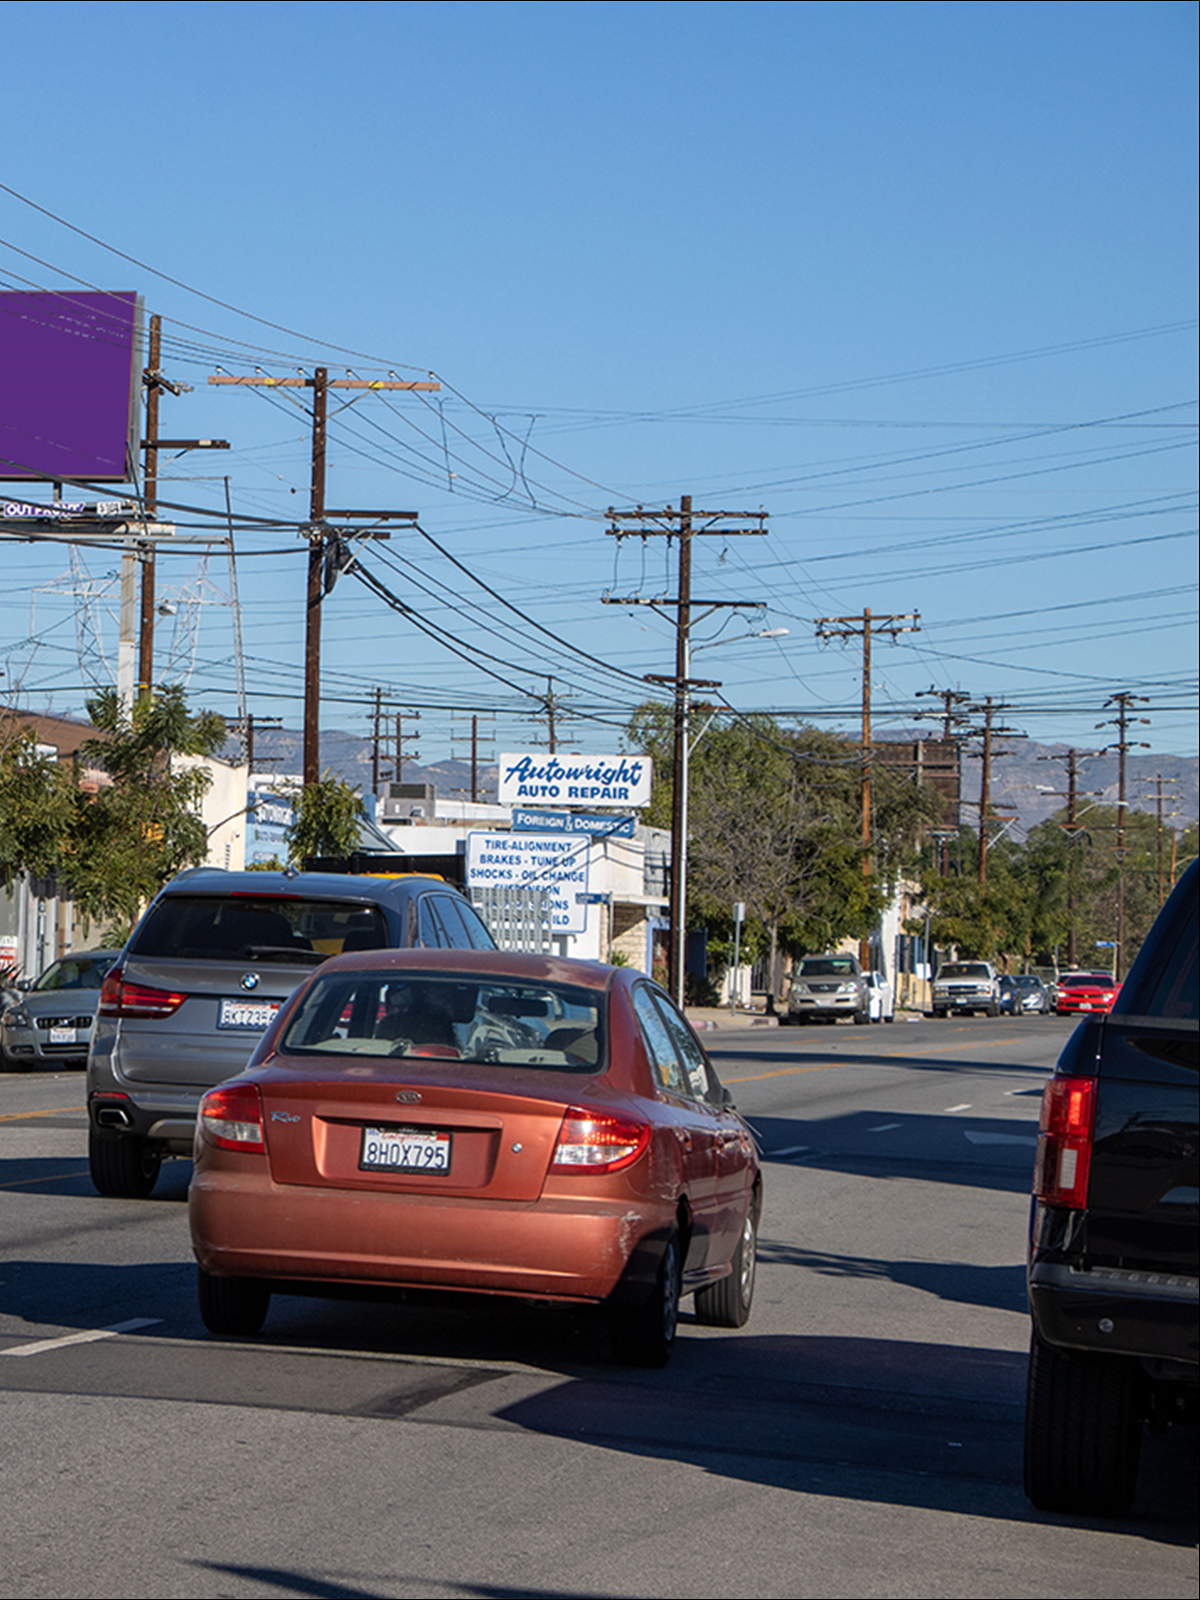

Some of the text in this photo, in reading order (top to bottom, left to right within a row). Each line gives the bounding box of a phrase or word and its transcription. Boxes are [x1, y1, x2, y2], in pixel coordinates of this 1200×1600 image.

[504, 755, 643, 787] Autowright
[517, 784, 630, 800] AUTO REPAIR
[517, 813, 630, 833] FOREIGN & DOMESTIC
[485, 839, 572, 852] TIRE-ALIGNMENT
[480, 854, 522, 865] BRAKES
[531, 855, 560, 867] TUNE
[562, 857, 577, 868] UP
[470, 868, 513, 880] SHOCKS
[521, 870, 542, 881] OIL
[542, 871, 585, 883] CHANGE
